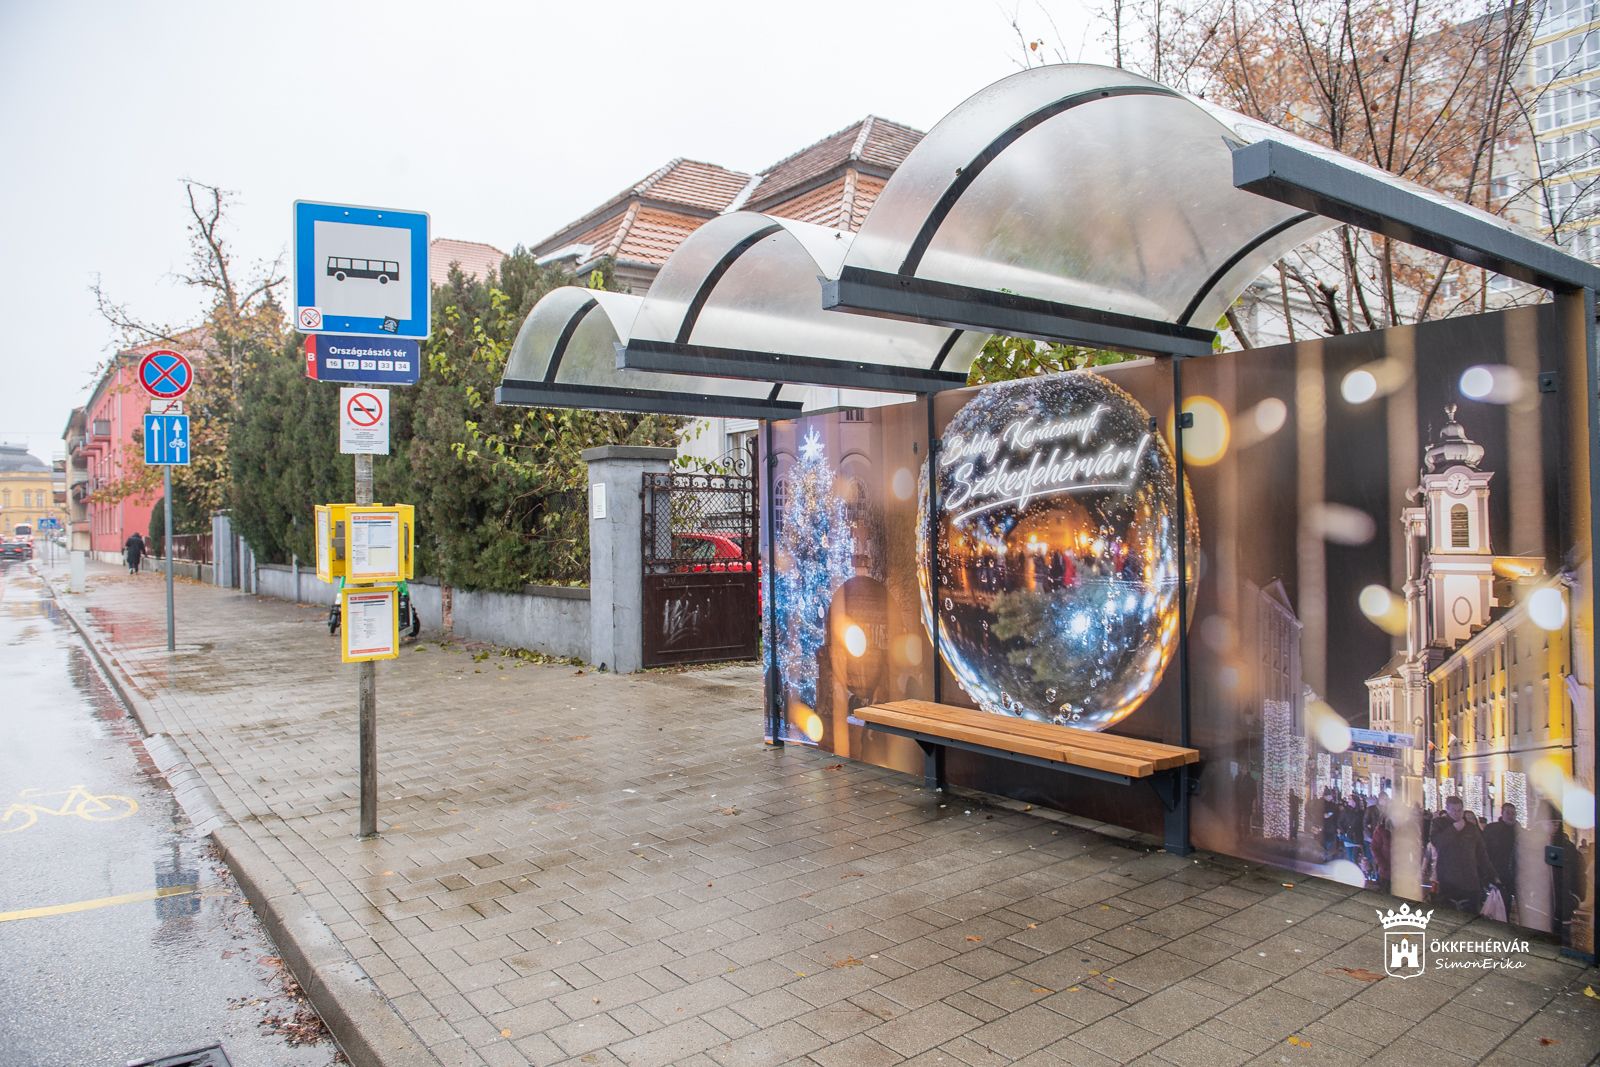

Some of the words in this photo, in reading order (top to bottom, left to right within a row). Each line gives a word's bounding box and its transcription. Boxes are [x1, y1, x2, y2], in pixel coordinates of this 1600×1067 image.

[307, 353, 315, 361] B
[329, 346, 391, 357] Országzászló
[393, 347, 407, 357] tér
[941, 431, 1000, 466] Boldog
[1003, 404, 1111, 450] Karácsonyt
[945, 433, 1151, 510] Székesfehérvár!
